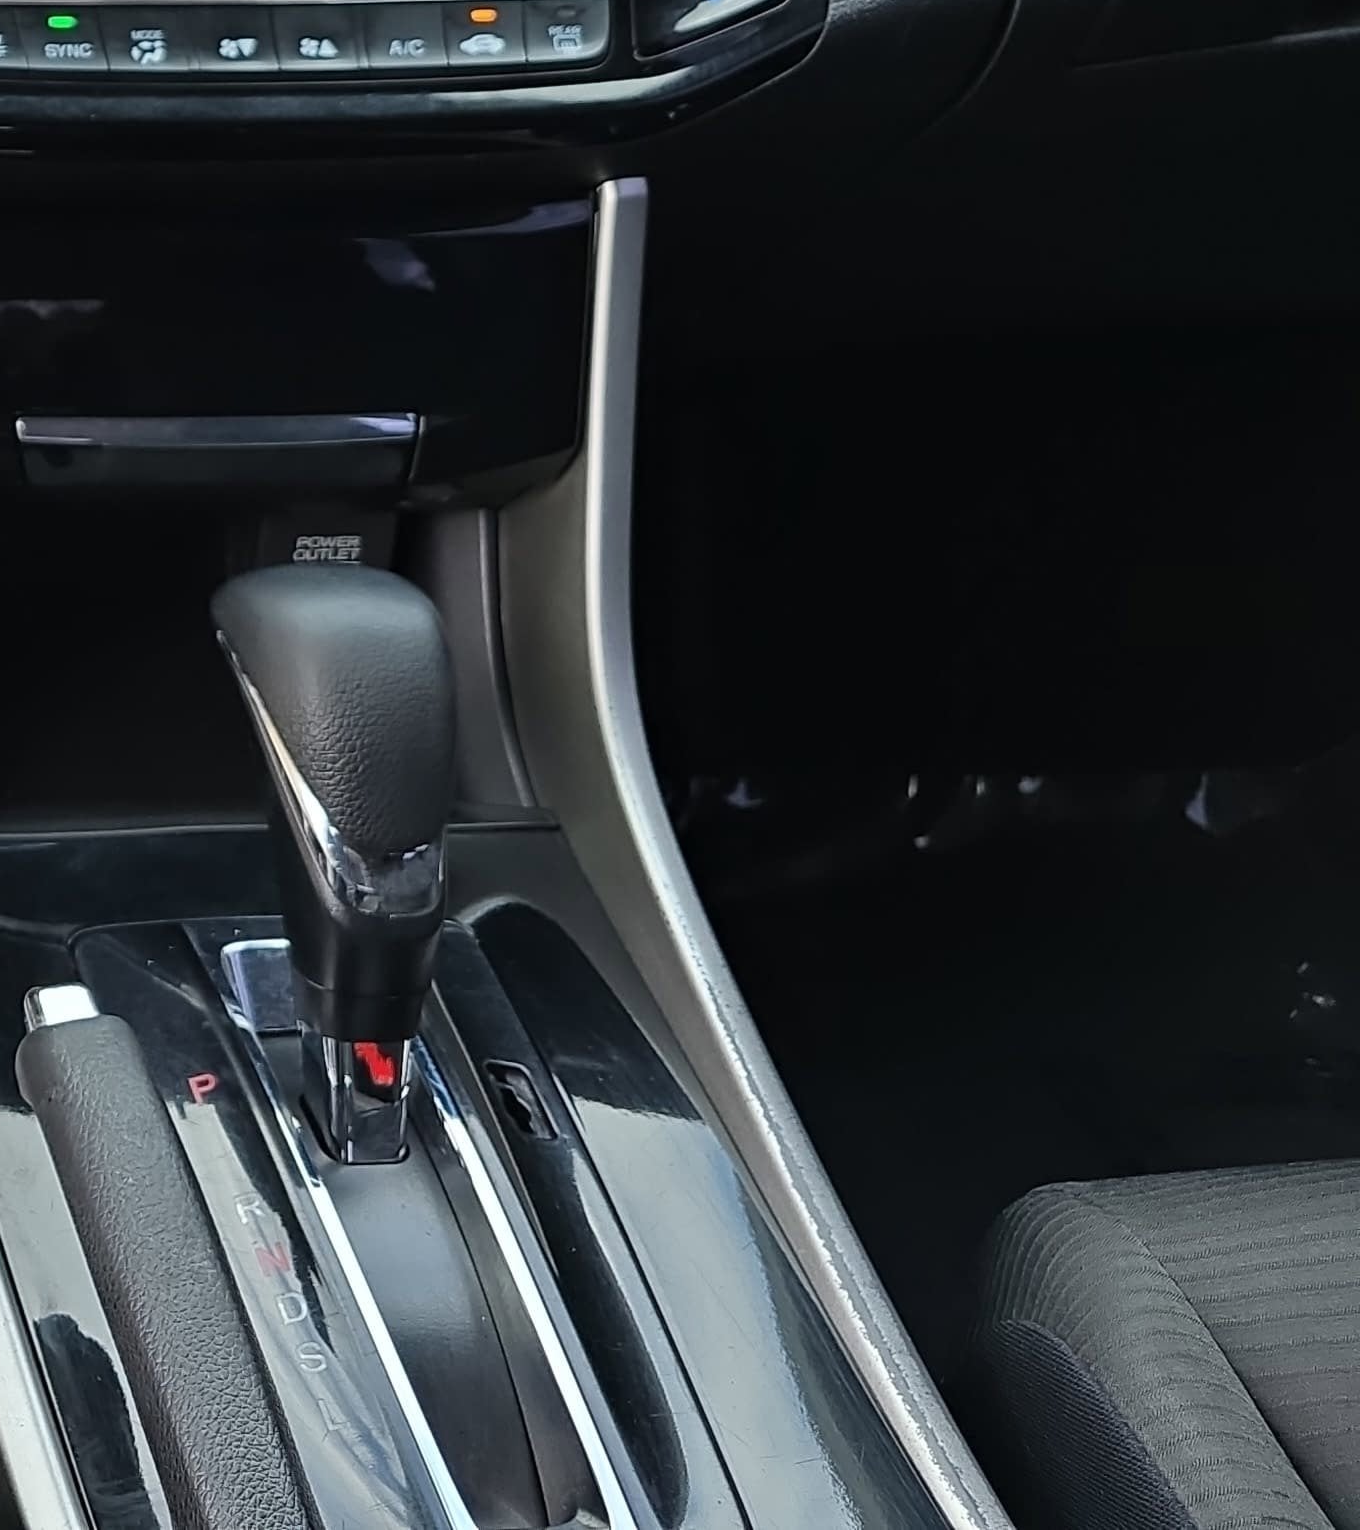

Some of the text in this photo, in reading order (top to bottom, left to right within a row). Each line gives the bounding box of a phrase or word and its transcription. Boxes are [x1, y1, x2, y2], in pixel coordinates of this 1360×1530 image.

[44, 42, 93, 59] SYNC
[388, 39, 426, 56] A/C
[292, 547, 361, 561] OUTLET
[295, 535, 362, 548] POWER
[186, 1073, 218, 1104] P
[233, 1193, 262, 1225] R
[253, 1241, 295, 1276] N
[277, 1295, 308, 1325] D
[298, 1341, 329, 1372] S
